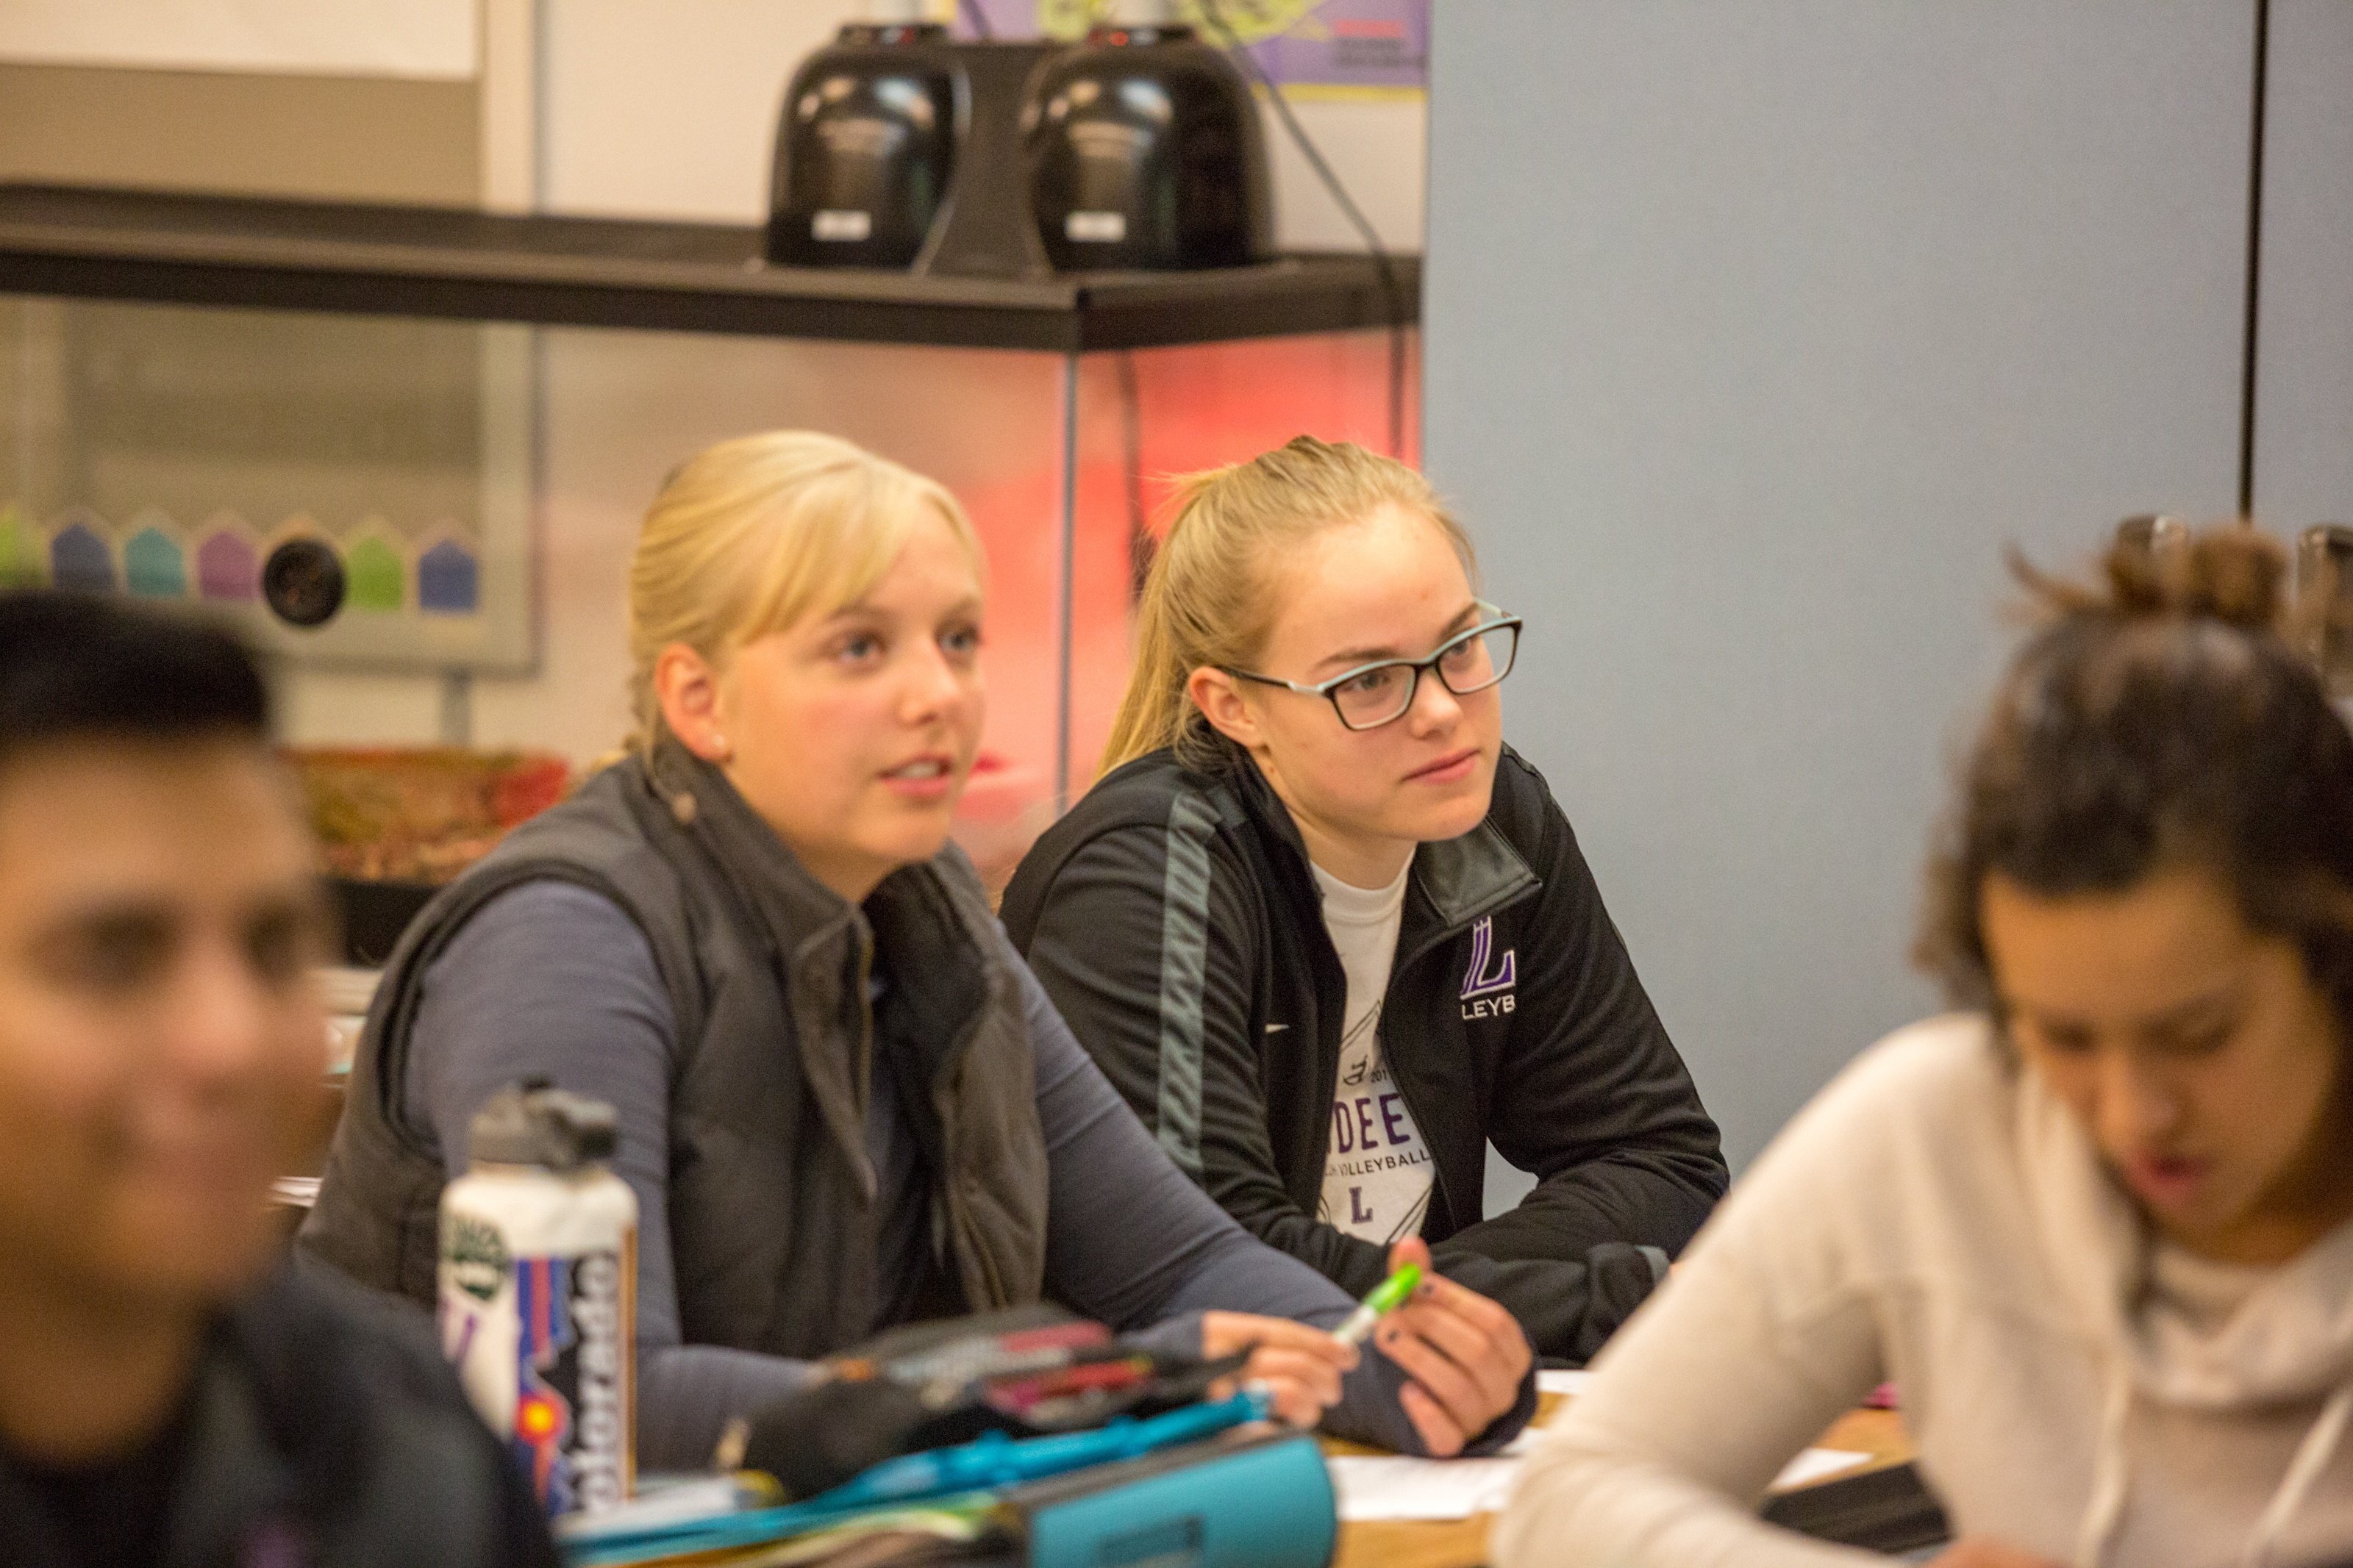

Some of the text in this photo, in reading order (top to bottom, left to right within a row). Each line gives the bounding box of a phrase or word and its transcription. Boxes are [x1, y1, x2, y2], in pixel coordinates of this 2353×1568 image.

[1460, 916, 1516, 1000] L
[1461, 994, 1516, 1020] LEYB
[1327, 1092, 1411, 1154] DEE
[1349, 1186, 1373, 1224] L
